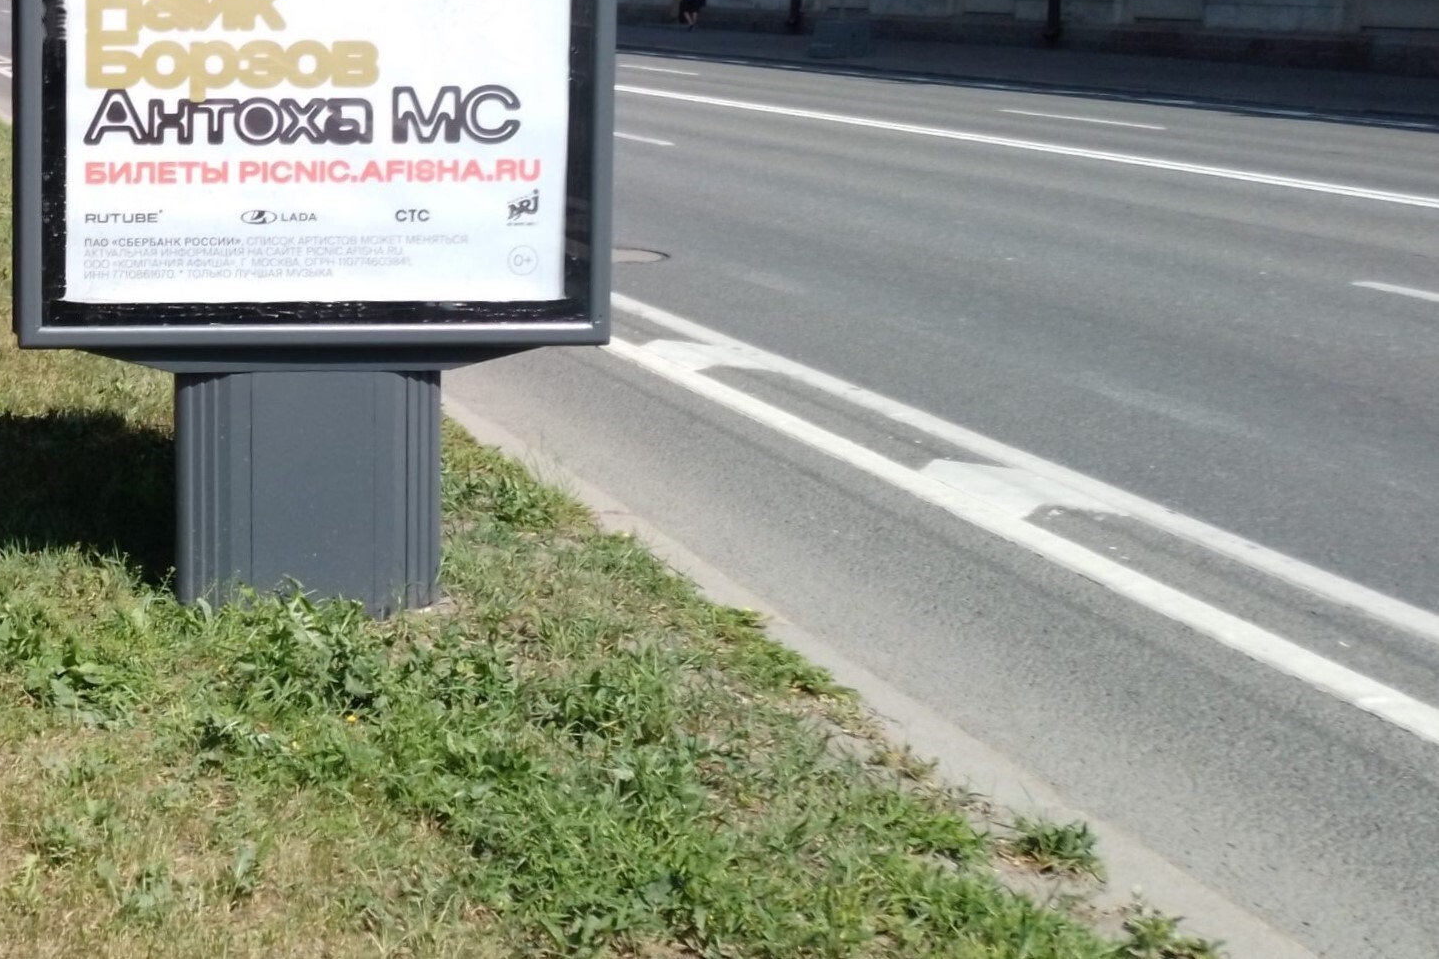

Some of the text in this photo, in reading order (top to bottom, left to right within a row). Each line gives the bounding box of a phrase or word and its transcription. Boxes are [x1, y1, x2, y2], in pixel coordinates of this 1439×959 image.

[85, 30, 380, 103] Борзов
[83, 88, 374, 146] Антоха
[84, 158, 542, 185] БИЛЕТЫ PICNIC.AFISHA.RU
[84, 212, 159, 224] RUTUBE
[280, 212, 318, 223] LADA
[84, 238, 109, 247] ПАО
[112, 237, 181, 247] «СБЕРБАНК
[246, 236, 295, 246] СПИСОК
[297, 236, 358, 245] АРТИСТОВ
[248, 247, 263, 256] НА
[514, 254, 533, 267] 0+
